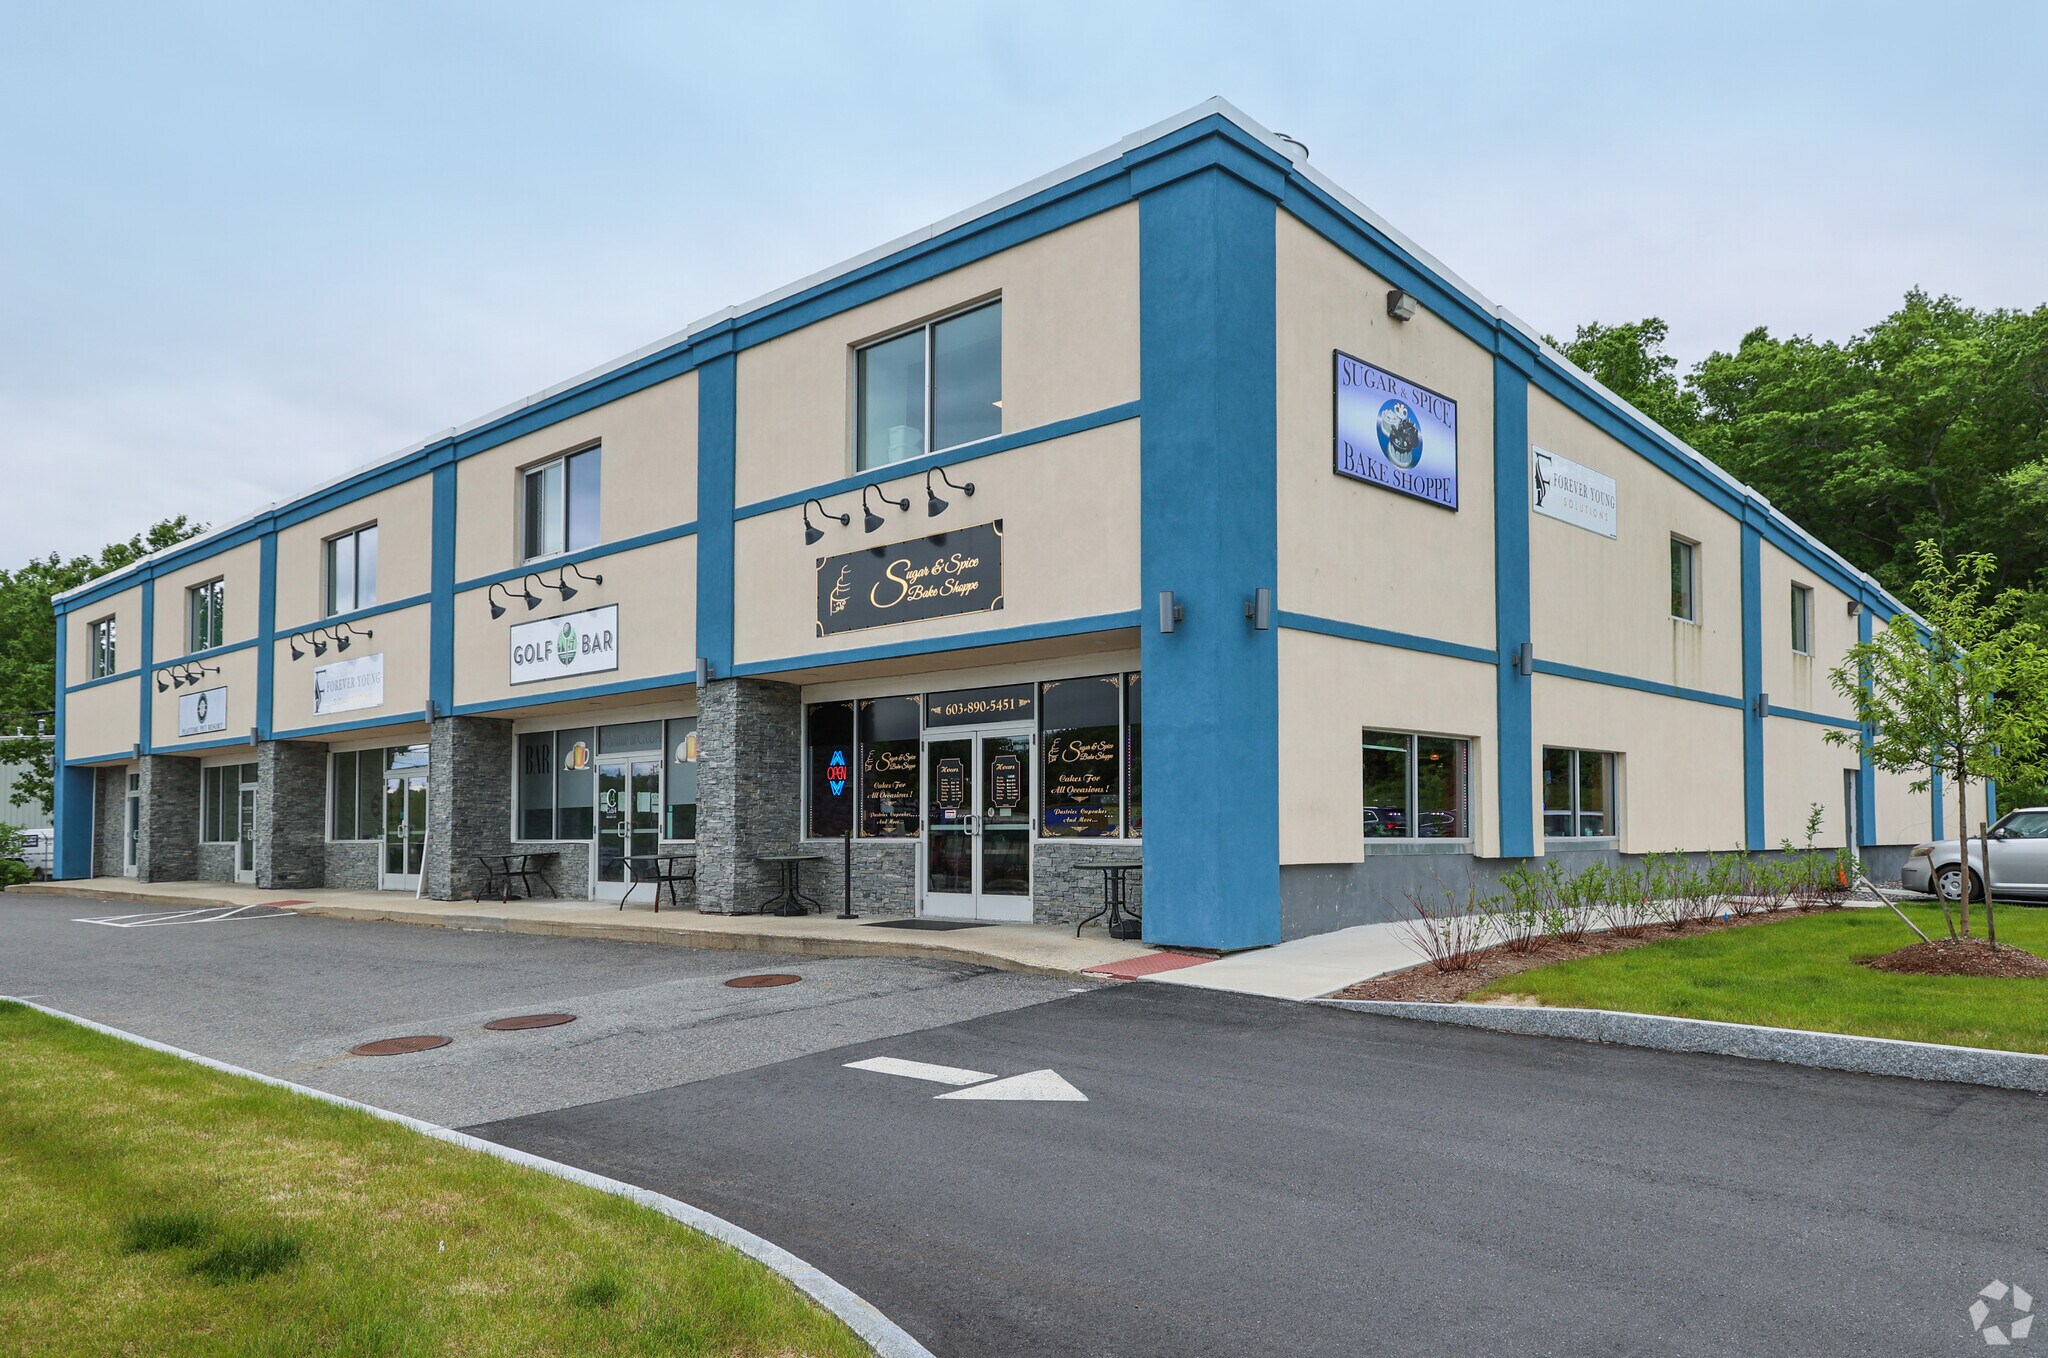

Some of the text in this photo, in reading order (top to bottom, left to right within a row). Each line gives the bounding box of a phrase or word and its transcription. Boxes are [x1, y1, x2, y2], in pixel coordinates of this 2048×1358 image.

[1342, 359, 1451, 429] SUGAR & SPICE
[1343, 440, 1452, 504] BAKE SHOPPE
[1553, 472, 1615, 509] FOREVER YOUNG
[1563, 497, 1608, 522] SOLUTIONS
[870, 553, 980, 609] Sugar & Spice
[907, 578, 979, 602] Bake Shoppe
[513, 630, 613, 666] GOLF BAR
[326, 672, 381, 693] FOREVER YOUNG
[945, 698, 1015, 716] 603-890-5451
[525, 743, 551, 775] BAR
[995, 763, 1015, 771] Hours
[827, 766, 847, 780] OPEN
[1059, 773, 1101, 783] Cakes For
[1050, 785, 1065, 794] All
[1066, 785, 1104, 794] Occasions
